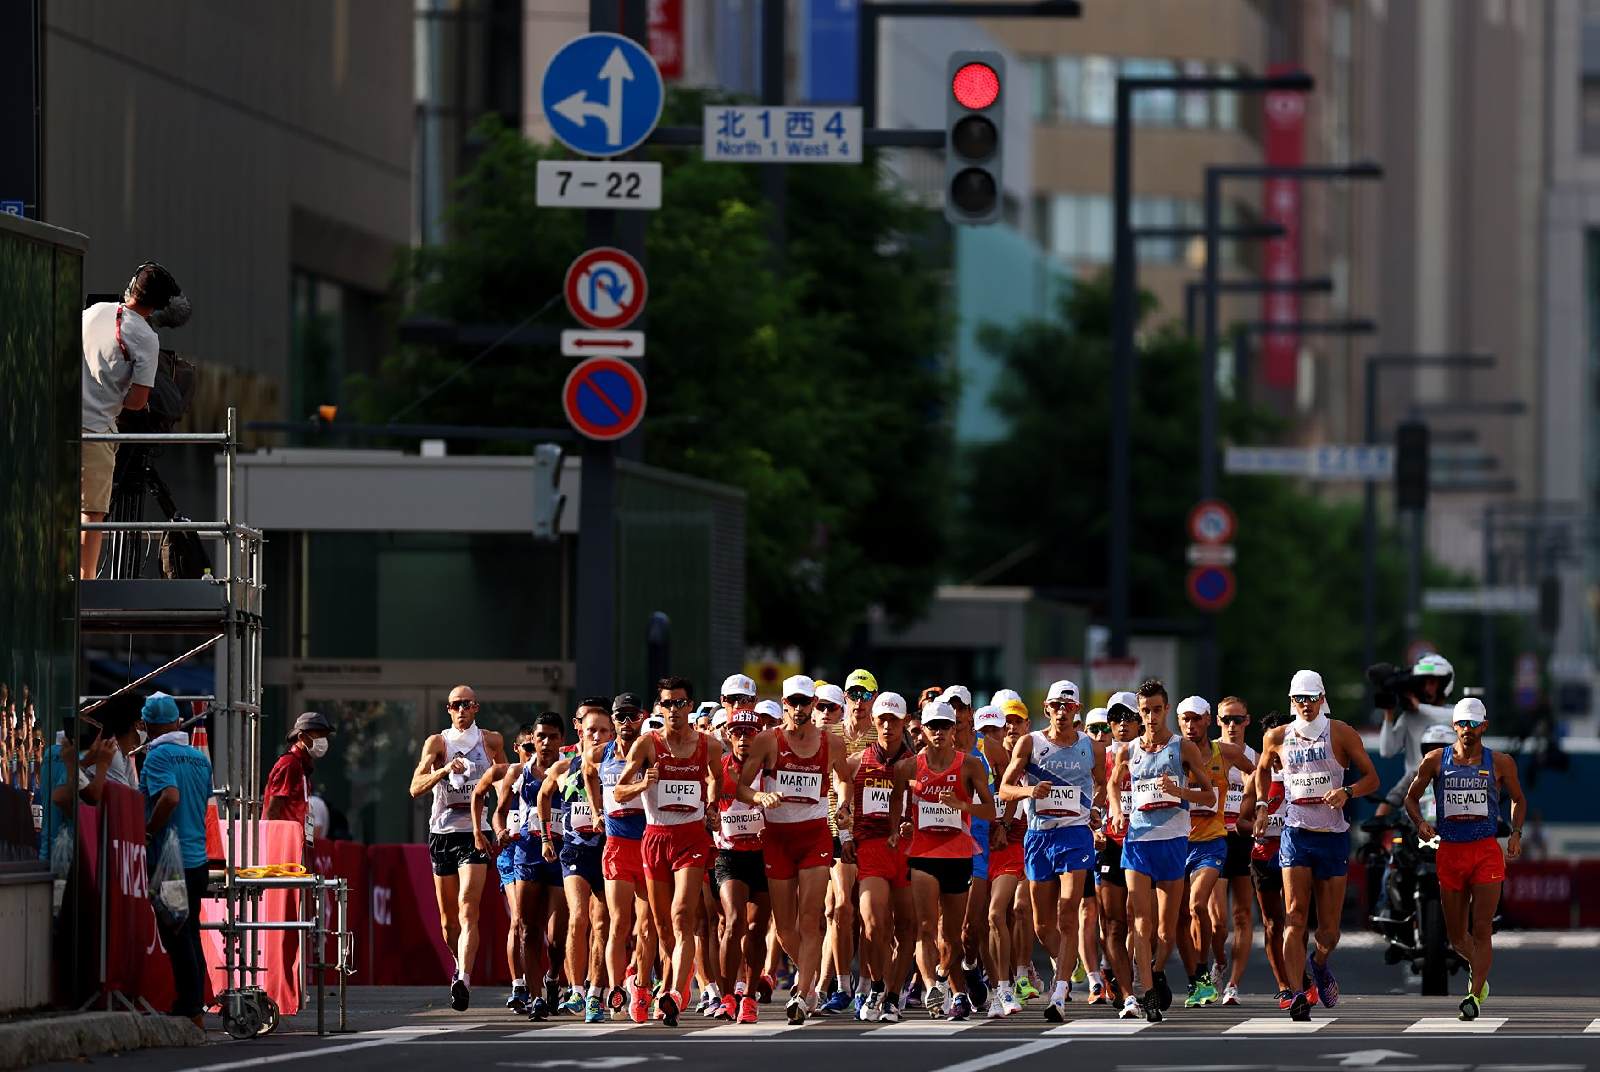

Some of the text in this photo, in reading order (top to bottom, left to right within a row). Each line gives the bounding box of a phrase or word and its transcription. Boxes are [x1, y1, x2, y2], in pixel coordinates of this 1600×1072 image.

[716, 142, 848, 155] North 1 West 4
[1046, 760, 1081, 770] ITALIA
[864, 777, 895, 788] CHIN
[1445, 777, 1488, 789] COLOMBIA
[665, 784, 695, 794] LOPEZ
[1446, 793, 1487, 805] AREVALO
[723, 812, 761, 824] RODRIGUEZ
